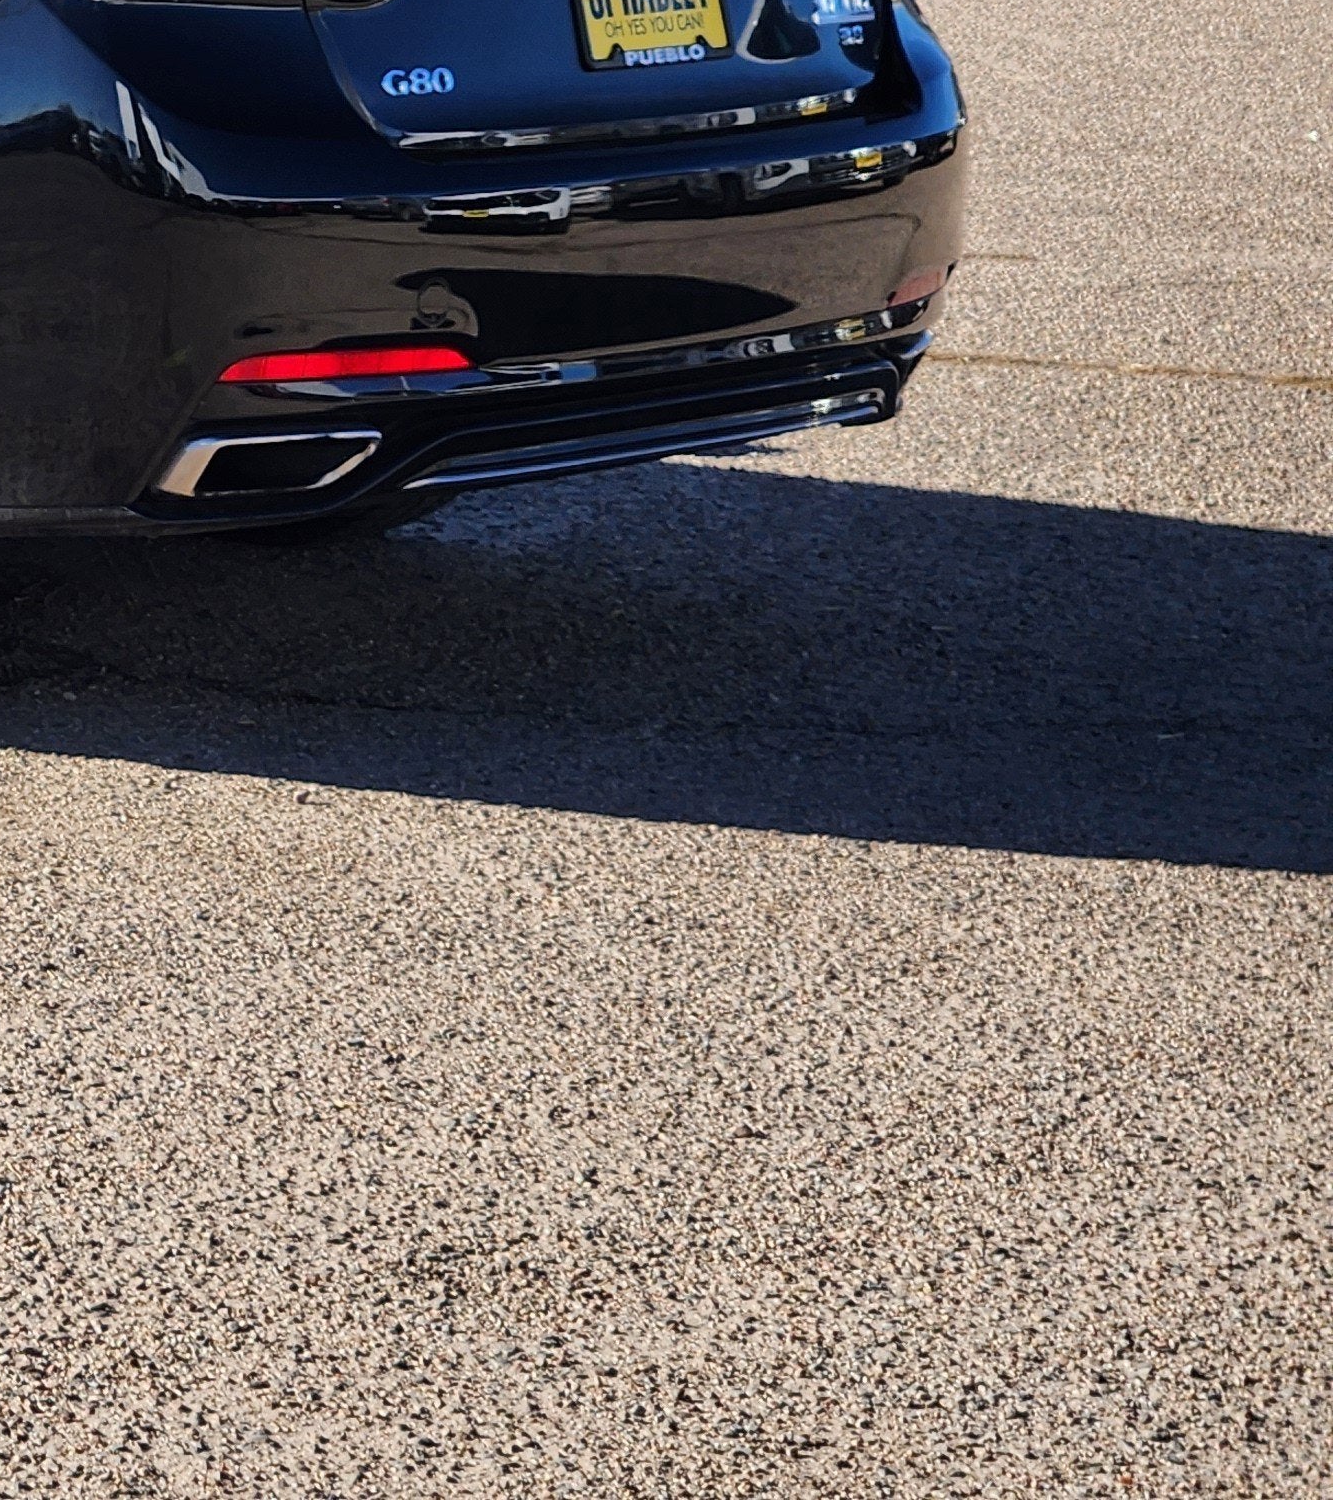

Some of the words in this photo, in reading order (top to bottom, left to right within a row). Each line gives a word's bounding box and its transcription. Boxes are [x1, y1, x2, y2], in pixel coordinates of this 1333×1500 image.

[604, 20, 625, 38] OH
[627, 16, 647, 36] YES
[649, 13, 675, 33] YOU
[677, 11, 705, 31] CAN!
[624, 43, 706, 67] PUEBLO
[380, 67, 455, 96] G80
